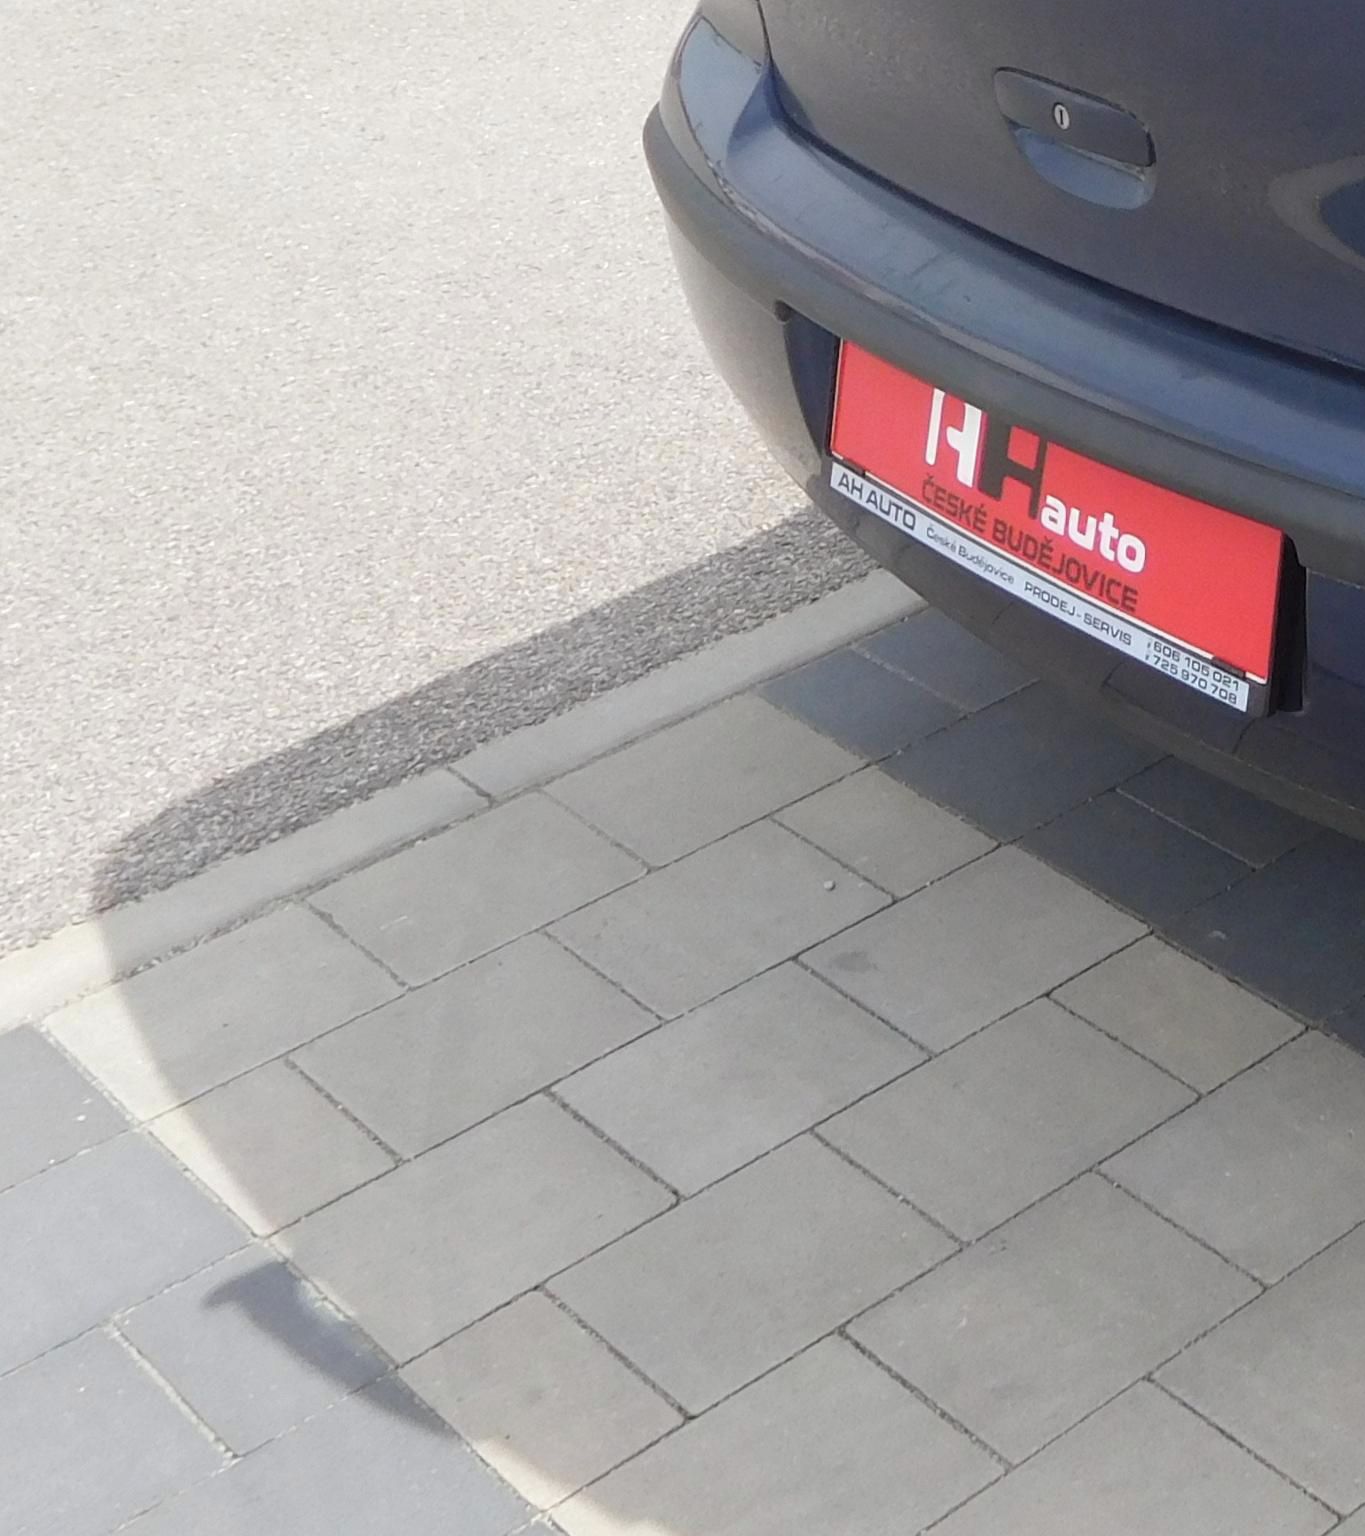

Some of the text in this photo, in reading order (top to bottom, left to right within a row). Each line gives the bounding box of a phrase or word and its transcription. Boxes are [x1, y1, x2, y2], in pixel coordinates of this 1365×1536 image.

[838, 472, 863, 500] AH
[866, 490, 916, 531] AUTO
[926, 526, 957, 553] České
[958, 544, 1014, 585] Budějovice
[1024, 581, 1076, 617] PRODEJ
[1083, 614, 1132, 646] SERVIS
[921, 473, 1138, 613] ČESKÉ BUDĚJOVICE
[1041, 494, 1146, 573] auto
[1153, 655, 1179, 676] 725
[1211, 684, 1238, 705] 708
[1212, 670, 1240, 692] 021
